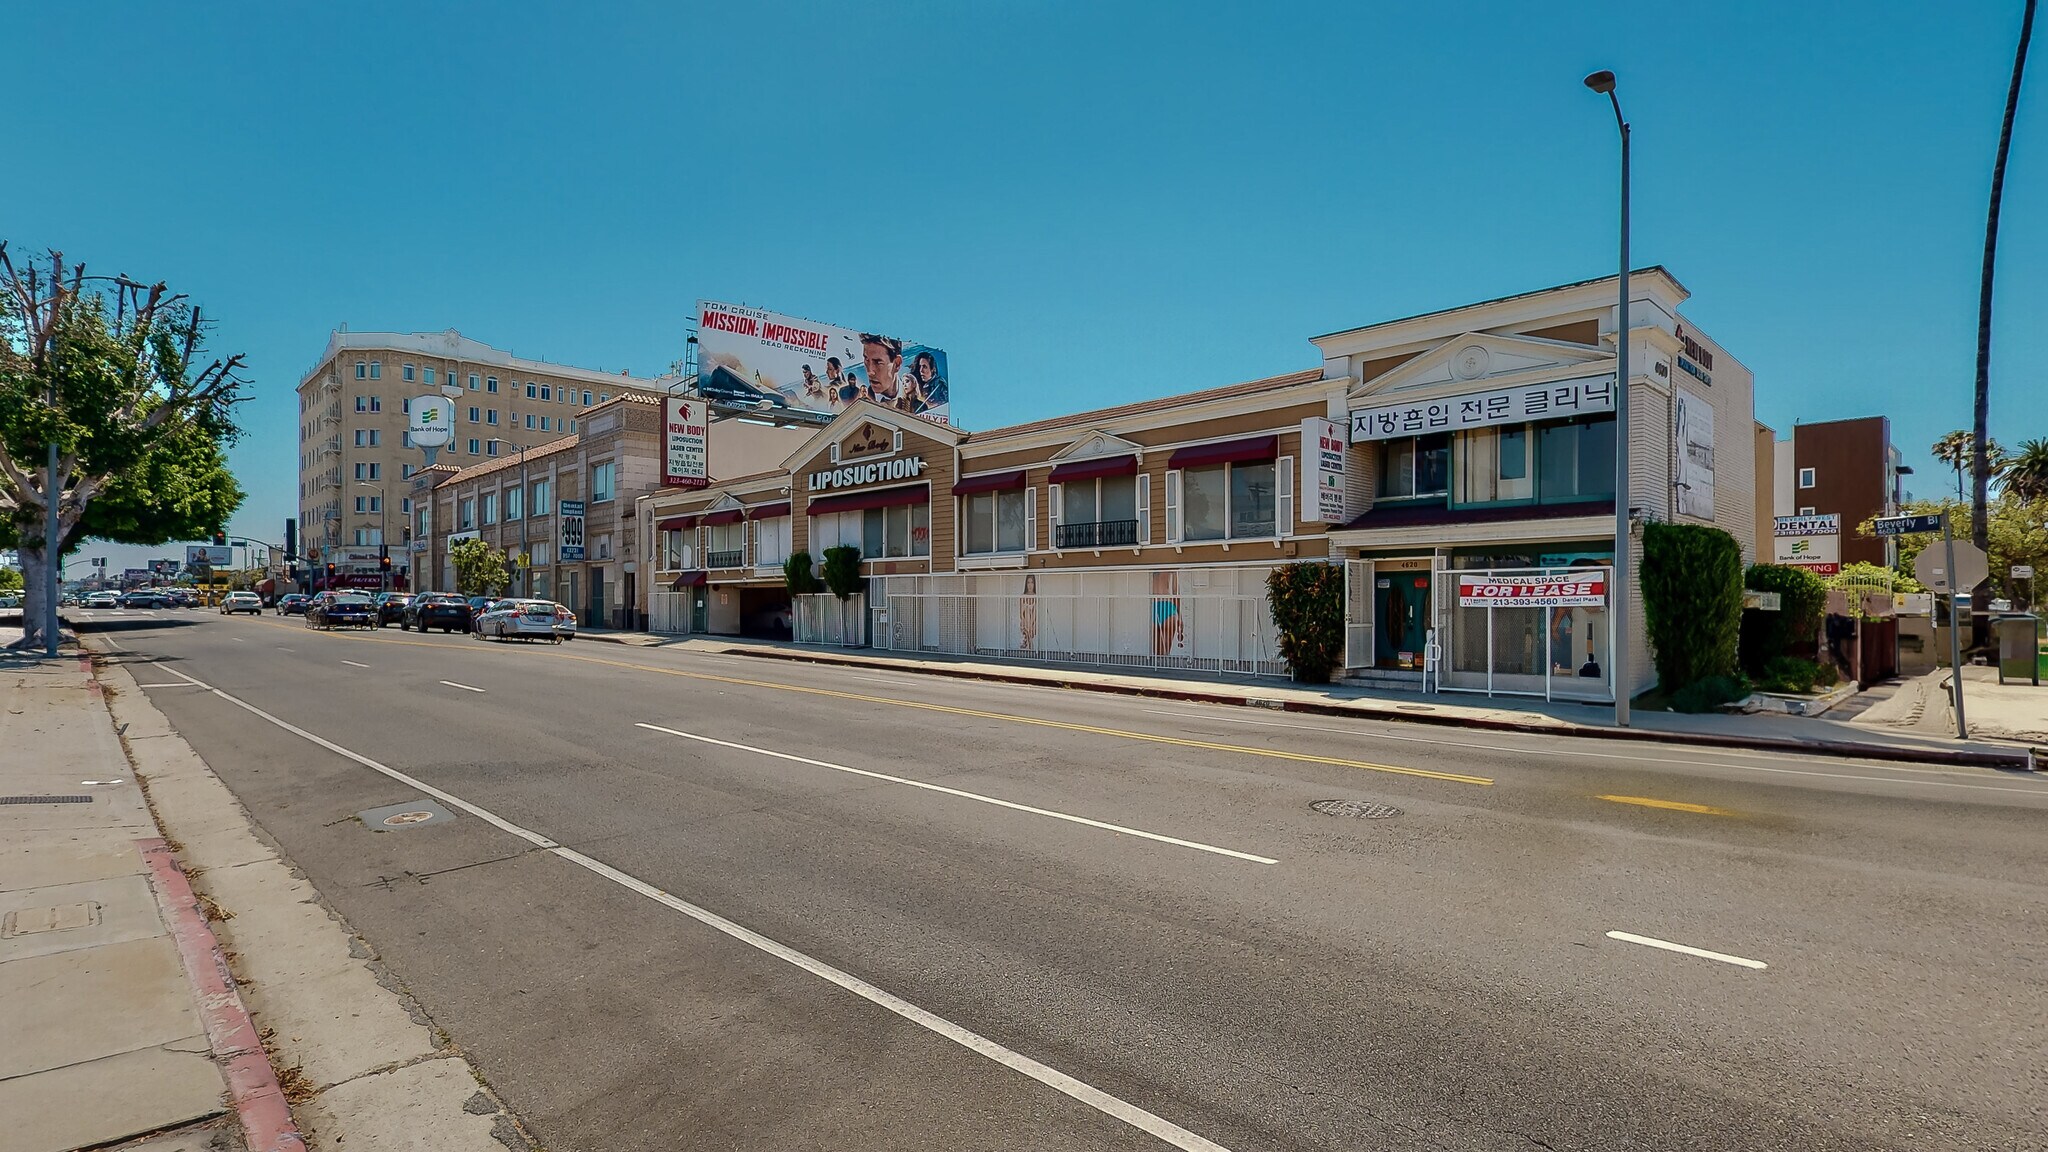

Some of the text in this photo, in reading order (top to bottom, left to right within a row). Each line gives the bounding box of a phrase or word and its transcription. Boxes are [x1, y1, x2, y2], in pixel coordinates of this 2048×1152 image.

[704, 302, 769, 320] TOM CRUISE
[702, 310, 828, 351] MISSION: IMPOSSIBLE
[761, 339, 827, 357] DEAD RECKONING
[1354, 381, 1611, 436] 지방흡입 전문 클리닉
[940, 416, 948, 424] 12
[669, 423, 705, 436] NEW BODY
[672, 436, 703, 444] LIPOSUCTION
[867, 438, 890, 451] Body
[808, 456, 919, 491] LIPOSUCTION
[1779, 520, 1837, 530] DENTAL
[1877, 515, 1938, 529] Beverly Bl
[1488, 575, 1570, 585] MEDICAL SPACE
[1471, 583, 1593, 597] FOR LEASE
